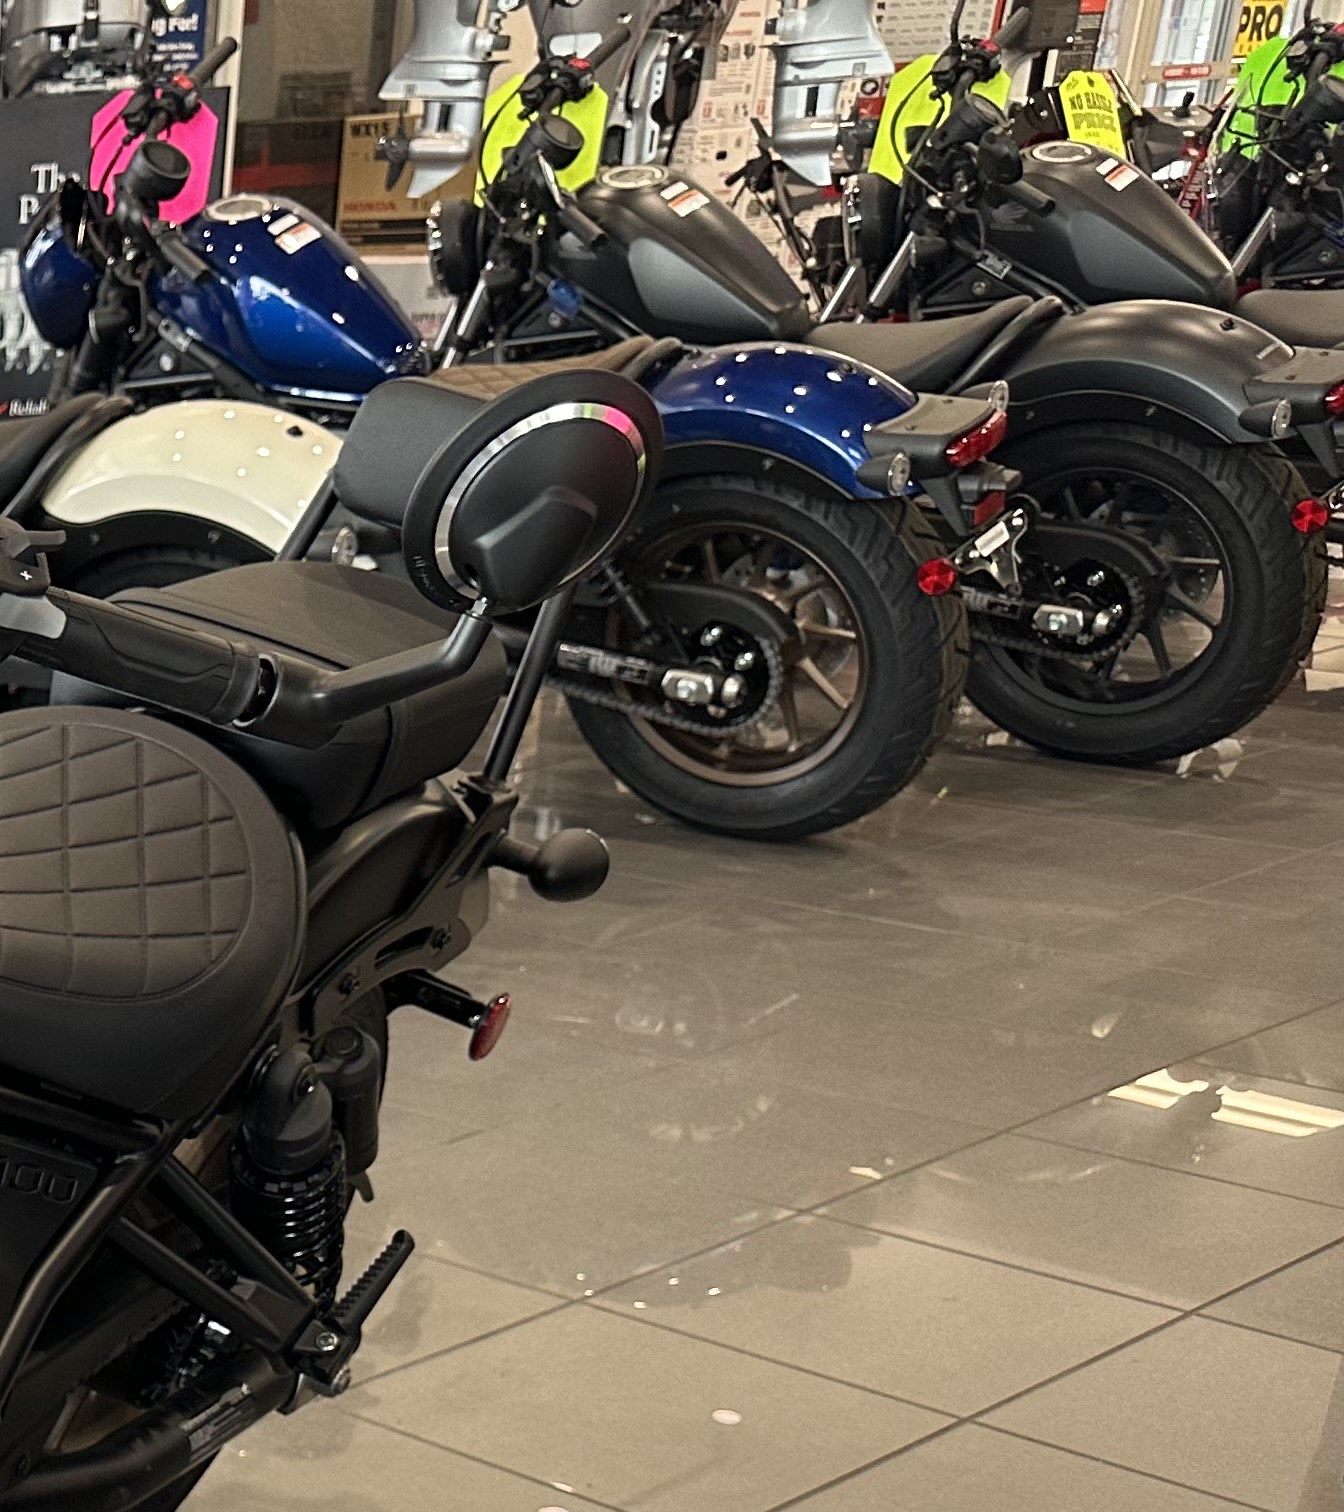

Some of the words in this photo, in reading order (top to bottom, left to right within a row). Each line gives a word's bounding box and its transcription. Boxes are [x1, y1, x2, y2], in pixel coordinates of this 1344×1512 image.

[1237, 4, 1283, 42] PRO
[1069, 93, 1083, 110] NO
[350, 122, 390, 138] WX15
